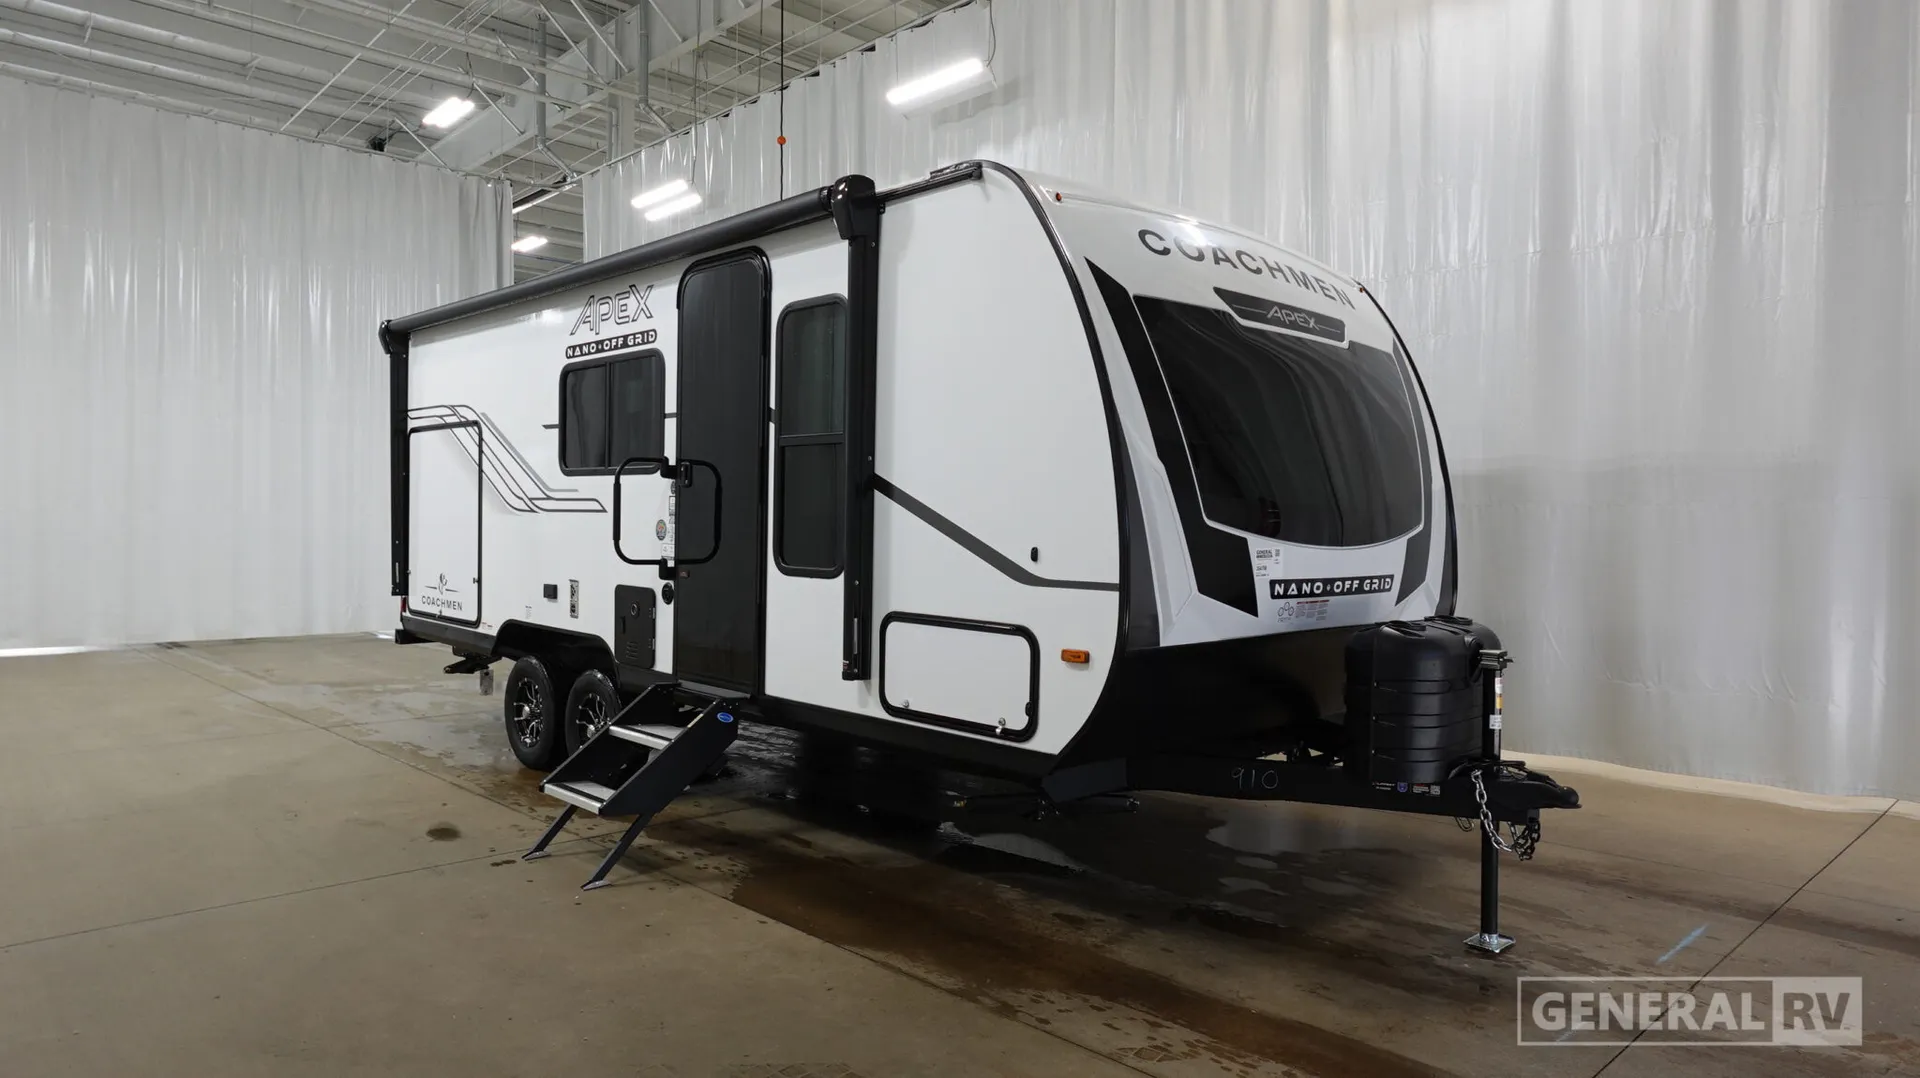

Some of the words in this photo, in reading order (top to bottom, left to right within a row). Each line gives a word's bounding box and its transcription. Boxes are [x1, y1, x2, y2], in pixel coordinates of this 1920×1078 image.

[1138, 229, 1355, 309] COACHMEN
[570, 284, 654, 336] APEX
[1267, 305, 1319, 330] APEX
[603, 338, 624, 351] OFF
[627, 332, 656, 345] GRID
[1333, 580, 1360, 593] OFF
[1363, 577, 1392, 590] GRID
[421, 596, 463, 611] COACHMEN
[1231, 767, 1279, 789] 910
